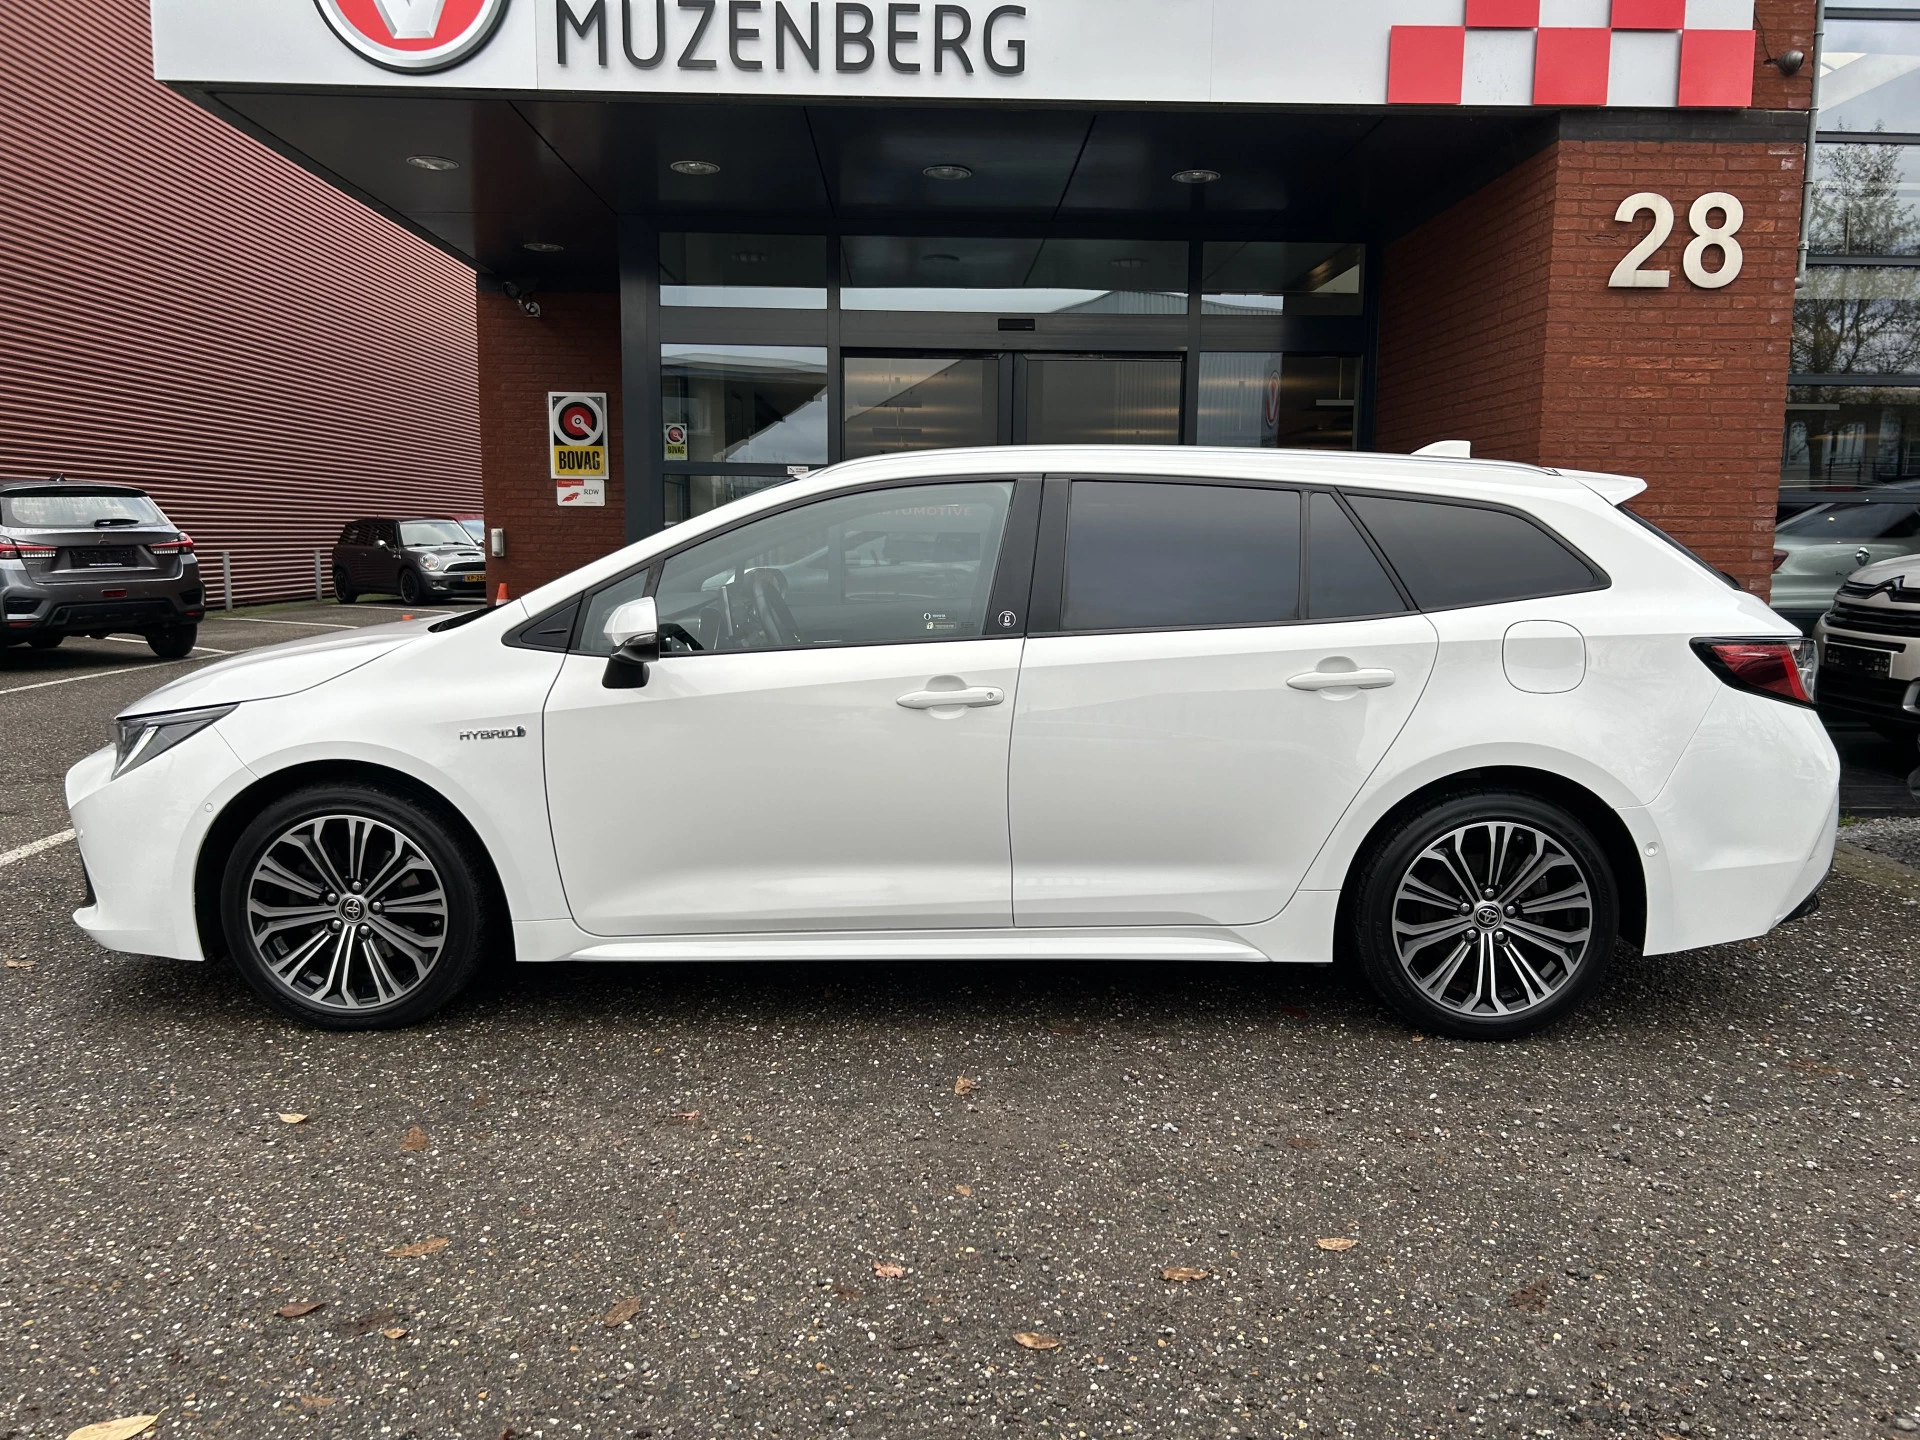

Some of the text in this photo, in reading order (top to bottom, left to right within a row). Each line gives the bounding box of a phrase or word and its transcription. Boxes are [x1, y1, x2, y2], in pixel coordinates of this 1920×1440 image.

[555, 0, 1027, 75] MUZENBERG
[1608, 192, 1744, 289] 28
[558, 450, 601, 470] BOVAG
[459, 729, 517, 741] HYBRID
